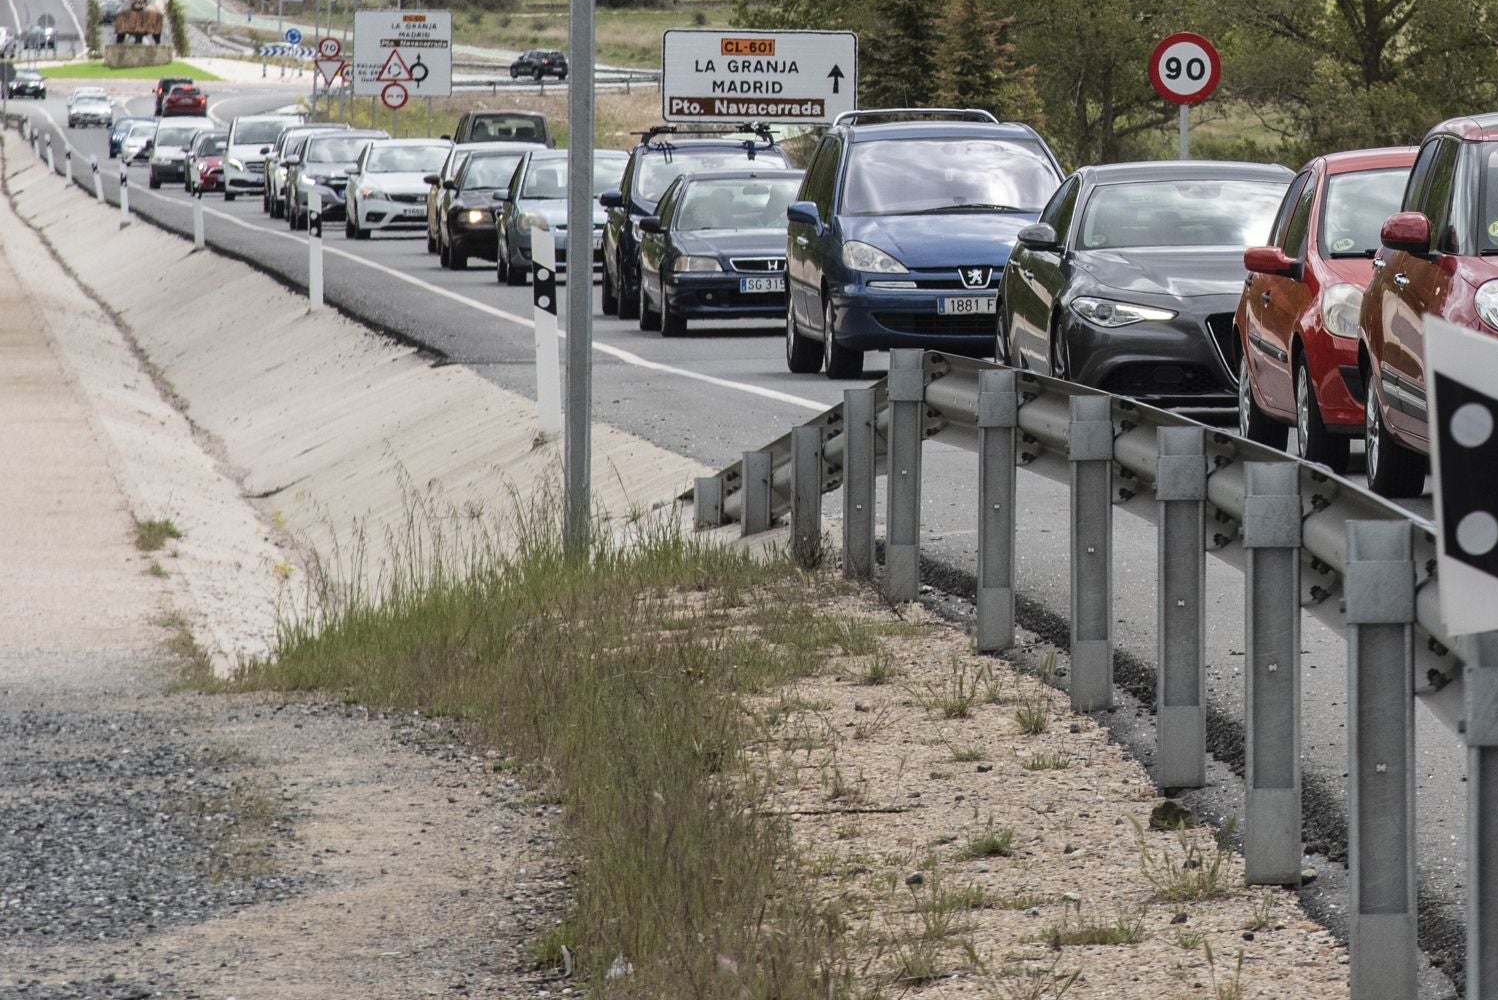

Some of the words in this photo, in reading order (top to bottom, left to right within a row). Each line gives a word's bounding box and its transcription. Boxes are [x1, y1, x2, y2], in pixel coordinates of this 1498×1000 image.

[724, 41, 773, 53] CL-601
[695, 60, 716, 73] LA
[727, 60, 799, 74] GRANJA
[1165, 56, 1206, 81] 90
[712, 80, 783, 94] MADRID
[672, 99, 704, 114] Pto.
[714, 99, 821, 116] Navacerrada
[748, 279, 762, 290] SG
[951, 299, 979, 312] 1881
[987, 299, 995, 311] F
